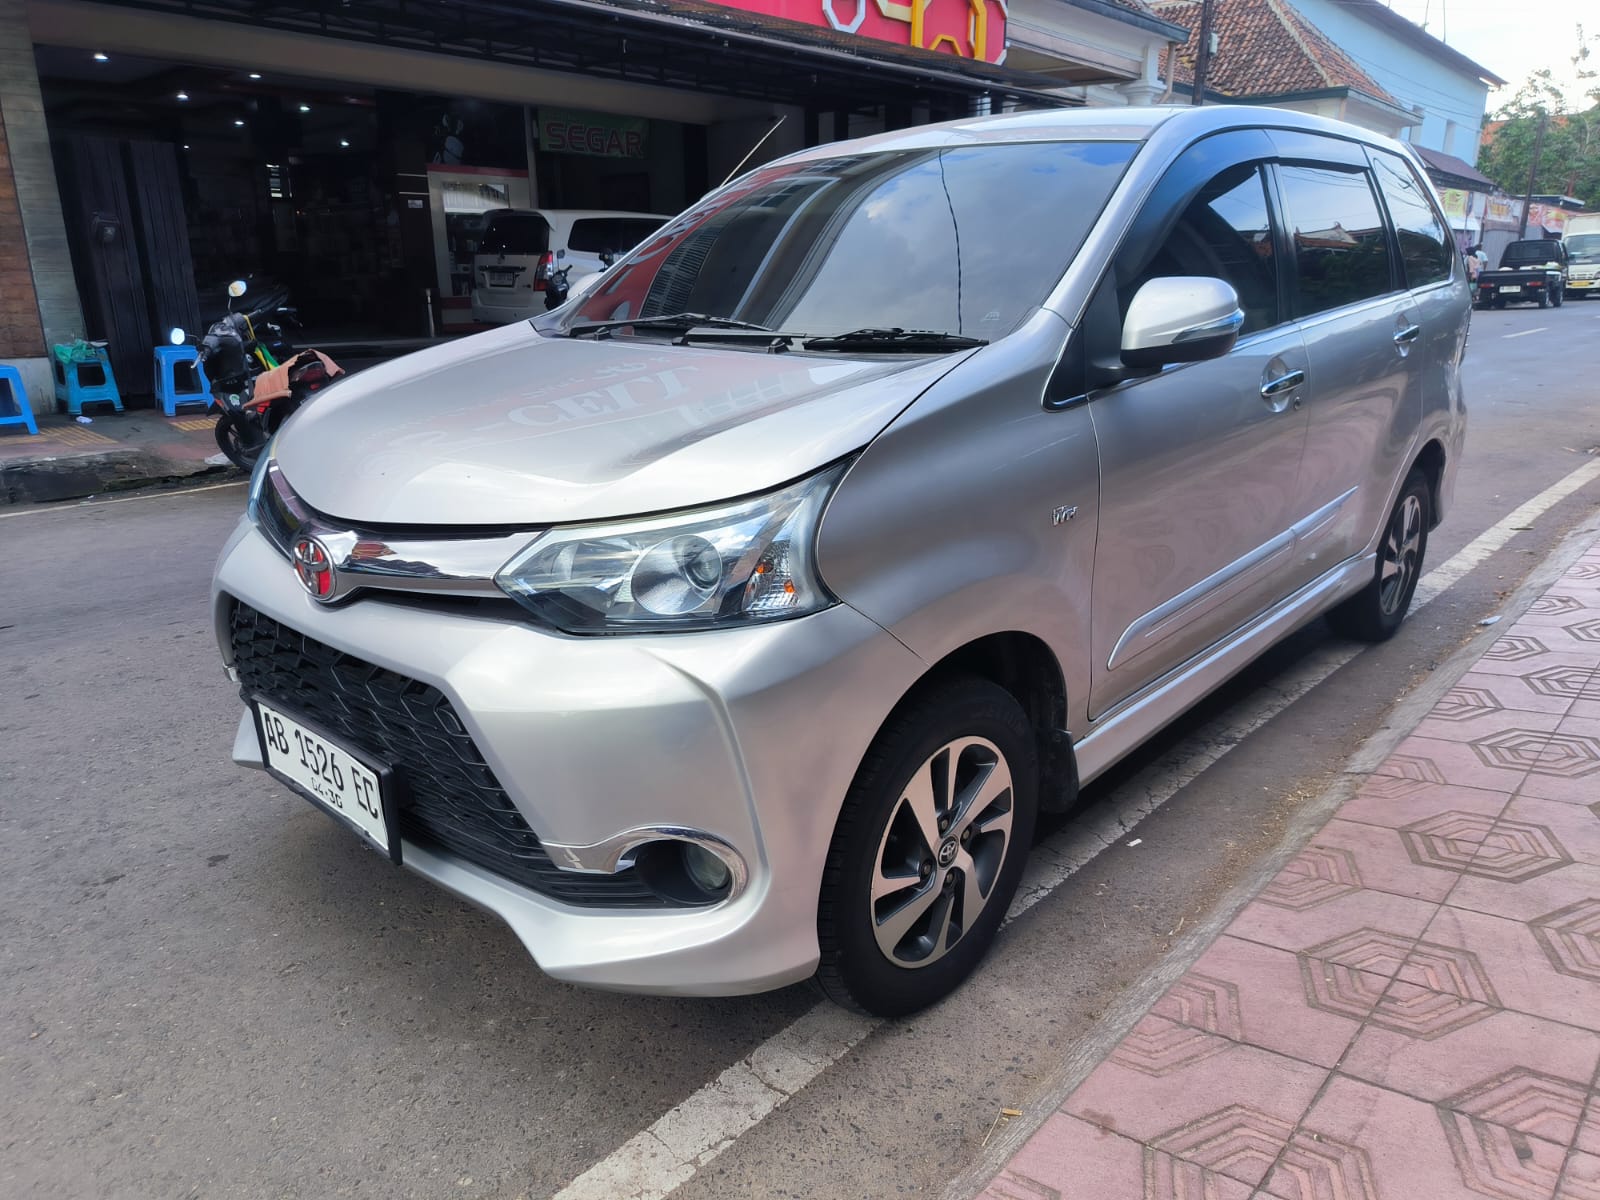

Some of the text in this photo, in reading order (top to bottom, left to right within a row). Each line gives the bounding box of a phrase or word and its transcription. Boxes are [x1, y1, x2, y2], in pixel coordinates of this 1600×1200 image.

[545, 122, 643, 158] SEGAR
[264, 713, 378, 819] AB 1526 EC
